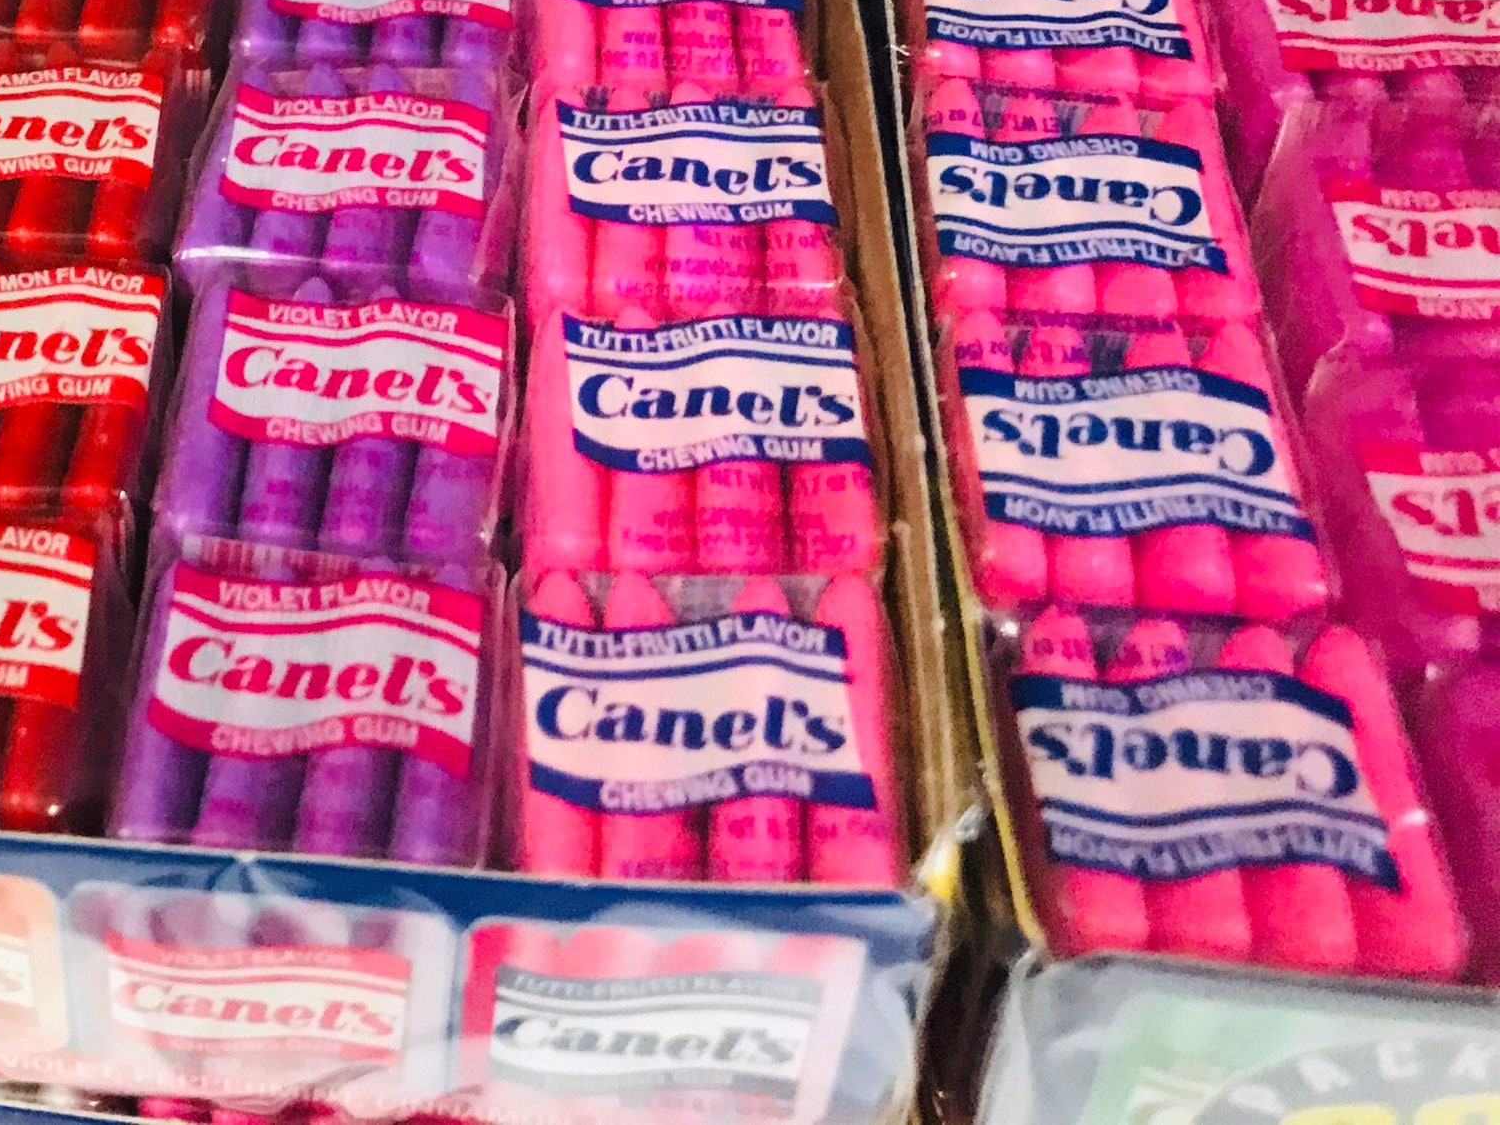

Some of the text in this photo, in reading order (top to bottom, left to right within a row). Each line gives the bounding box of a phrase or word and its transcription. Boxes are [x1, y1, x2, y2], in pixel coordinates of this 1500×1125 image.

[937, 18, 1175, 57] TUTTI-FRUTTI FLAVOR
[64, 69, 143, 89] FLAVOR
[273, 95, 446, 121] VIOLET FLAVOR
[572, 105, 806, 131] TUTTI-FRUTTI FLAVOR
[64, 157, 114, 176] GUM
[233, 136, 480, 189] Canel's
[970, 135, 1139, 161] CHEWING GUM
[572, 149, 823, 195] Canel's
[272, 188, 439, 214] CHEWING GUM
[628, 203, 794, 223] CHEWING GUM
[939, 164, 1202, 227] Canel's
[56, 268, 145, 295] FLAVOR
[268, 300, 458, 333] VIOLET FLAVOR
[578, 320, 840, 353] TUTTI-FRUTTI FLAVOR
[57, 378, 112, 399] GUM
[224, 345, 492, 416] Canel's
[1014, 370, 1201, 401] CHEWING GUM
[576, 371, 856, 429] Canel's
[266, 413, 450, 445] CHEWING GUM
[982, 408, 1277, 477] Canel's
[636, 435, 824, 471] CHEWING GUM
[219, 578, 430, 609] VIOLET FLAVOR
[536, 616, 828, 660] TUTTI-FRUTTI FLAVOR
[168, 636, 468, 718] Canel's
[211, 716, 421, 756] CHEWING GUM
[534, 683, 848, 756] Canel's
[1028, 721, 1359, 800] Canel's
[600, 764, 814, 811] CHEWING GUM
[115, 980, 394, 1037] Canel's
[504, 1013, 797, 1065] Canel's
